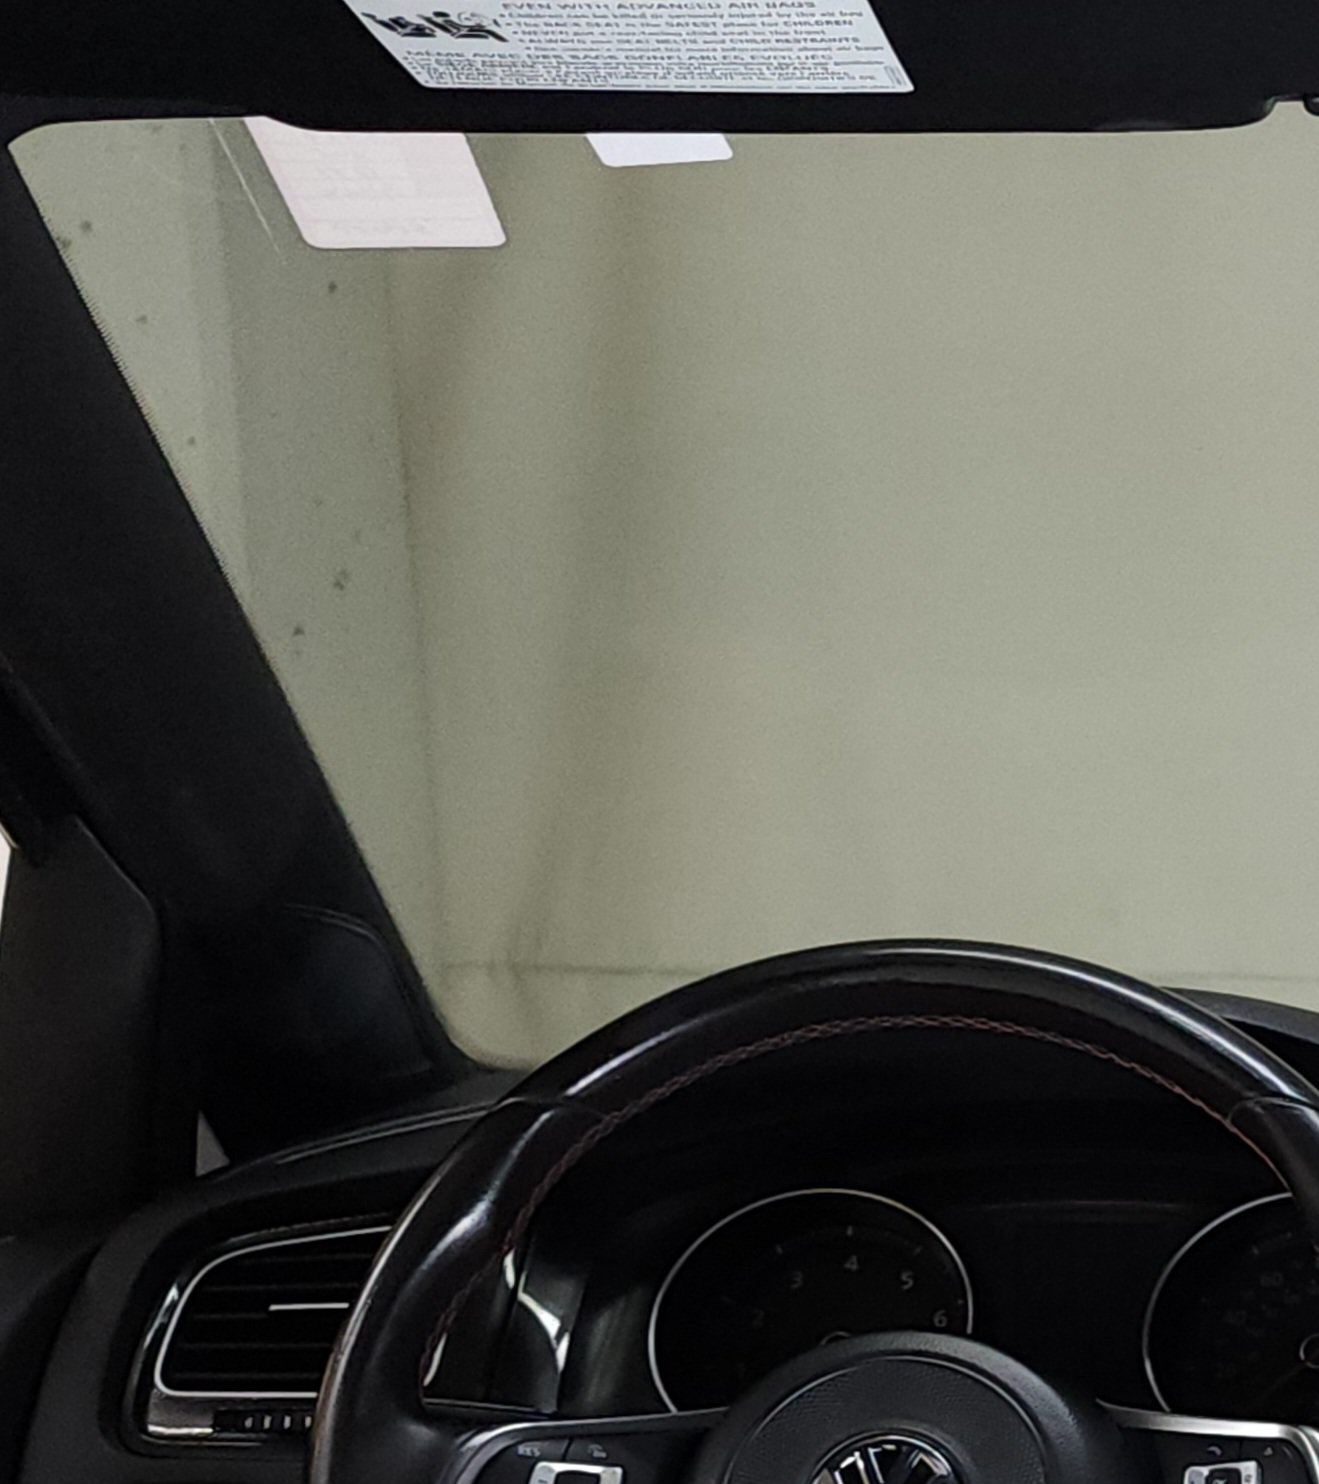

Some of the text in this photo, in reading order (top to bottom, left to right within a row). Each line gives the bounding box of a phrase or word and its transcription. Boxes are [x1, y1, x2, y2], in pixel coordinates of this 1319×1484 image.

[843, 1254, 860, 1272] 4
[788, 1270, 804, 1290] 3
[898, 1270, 916, 1291] 5
[932, 1309, 949, 1328] 6
